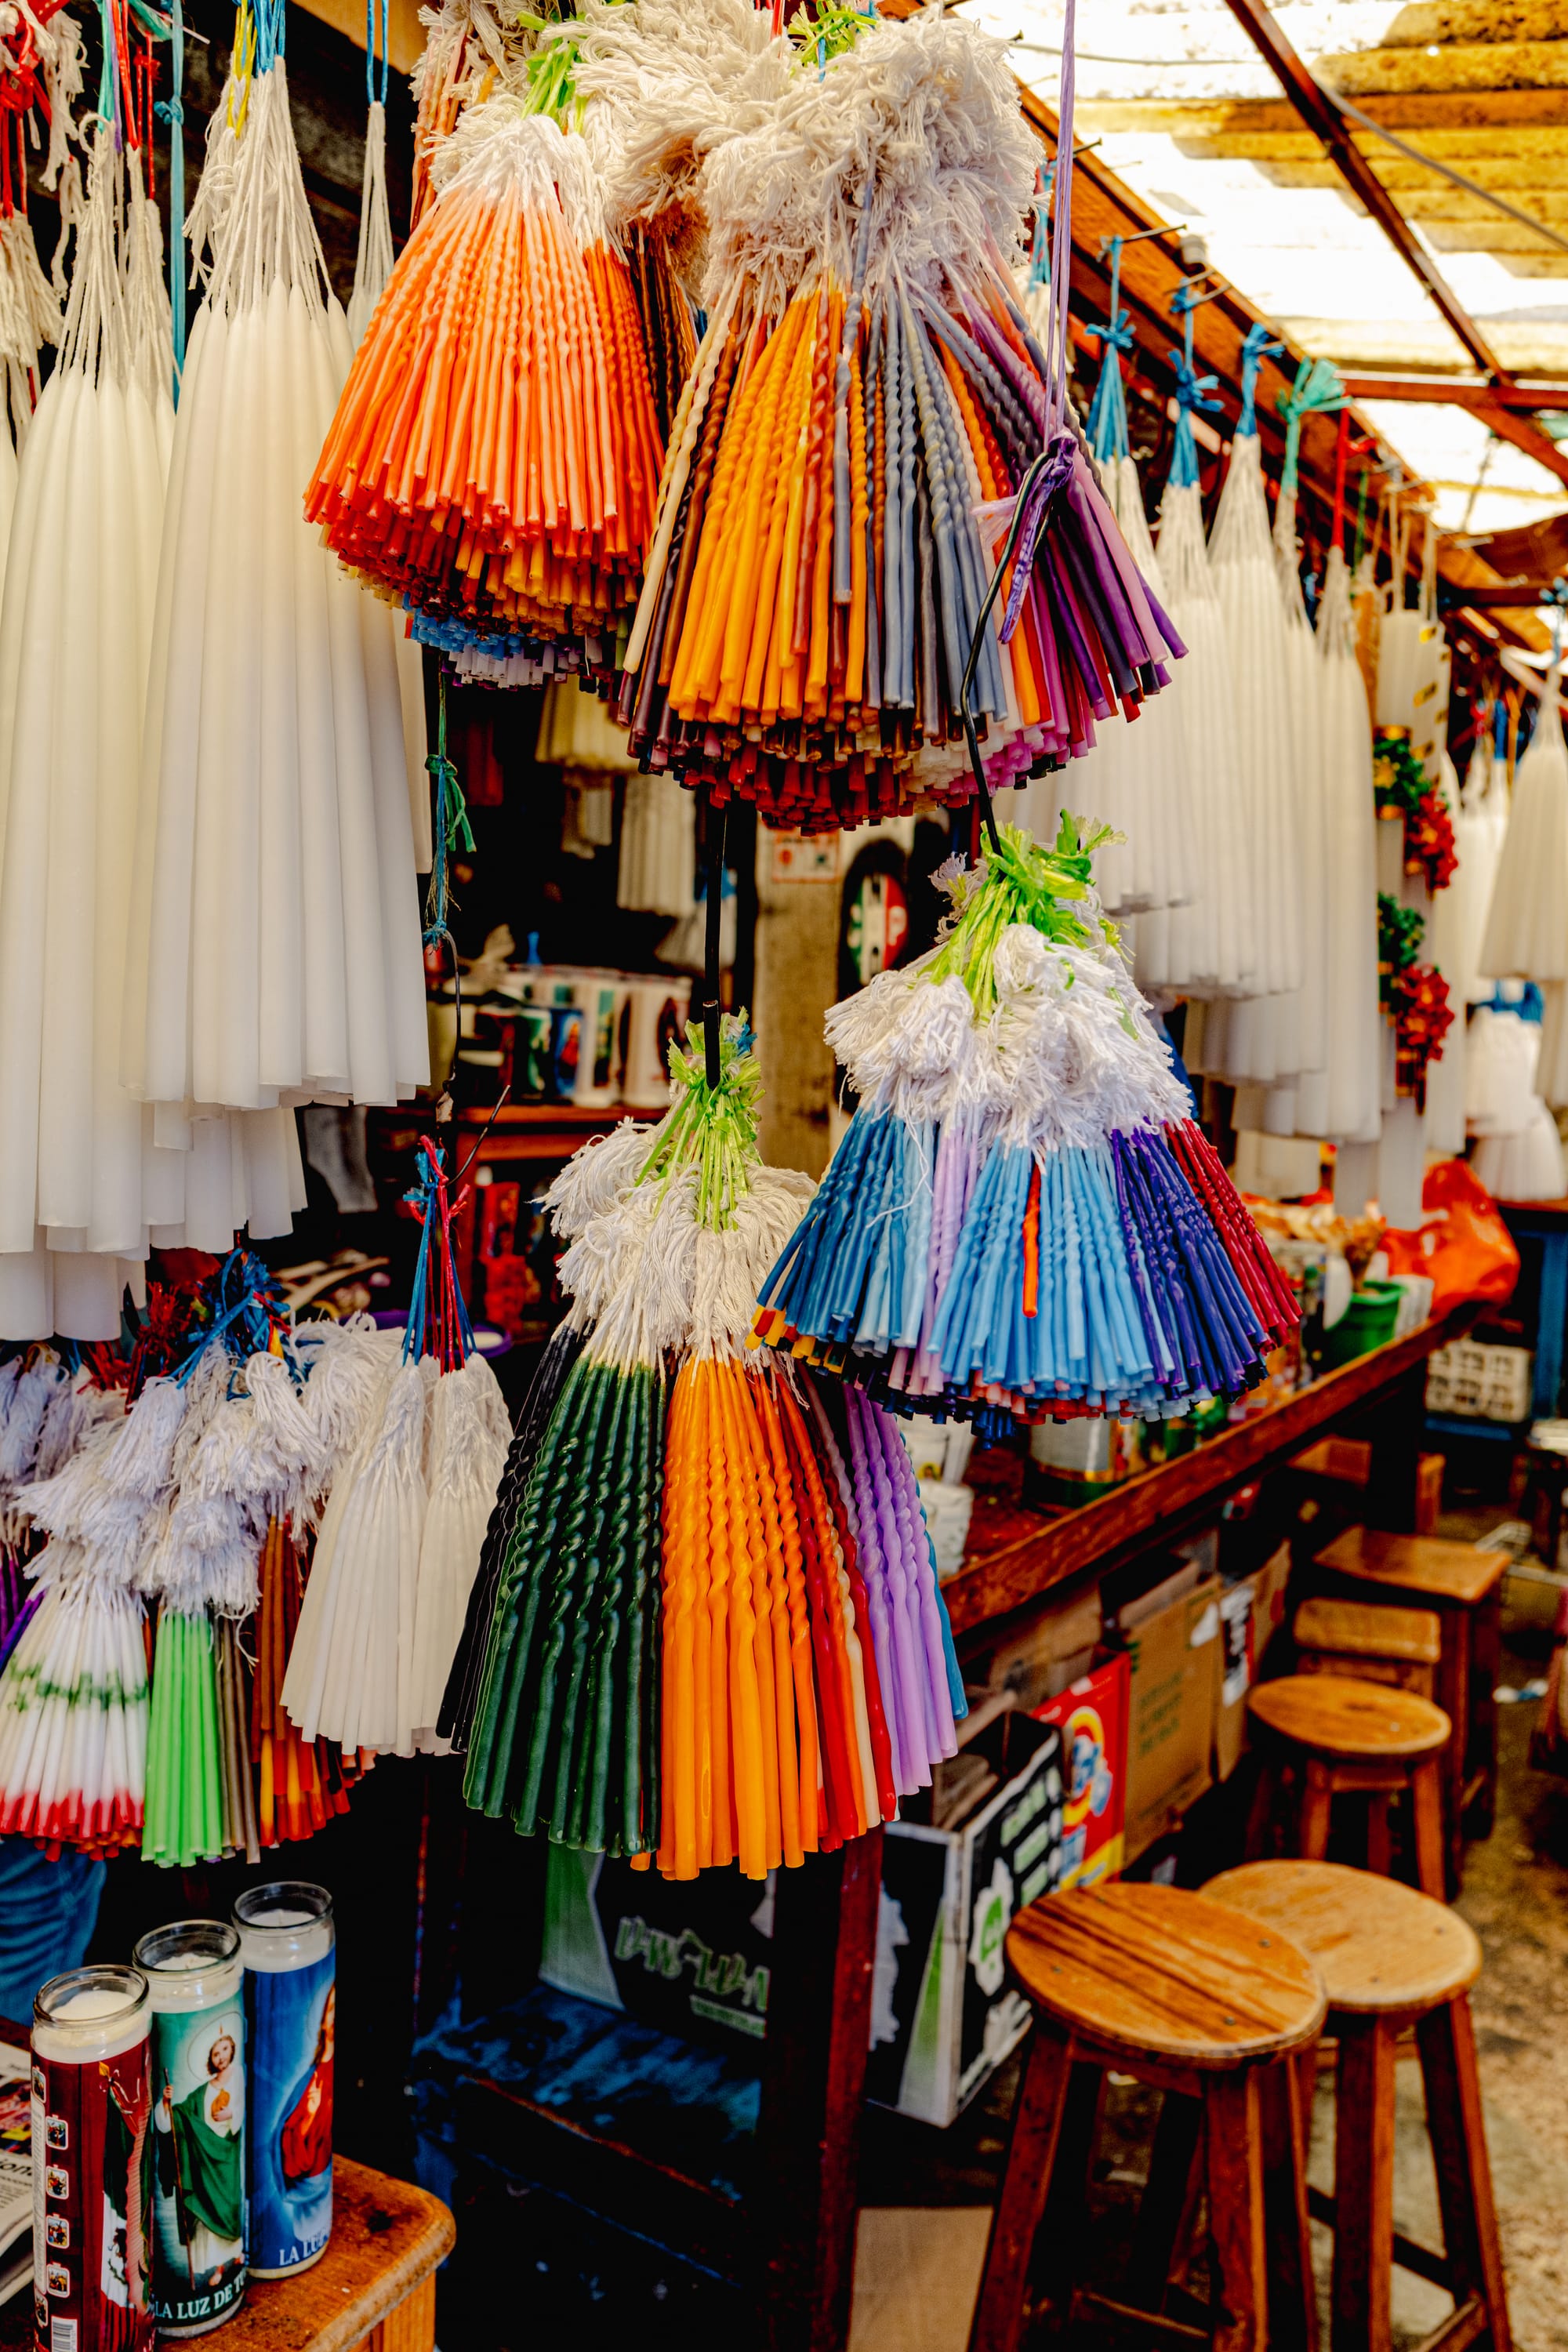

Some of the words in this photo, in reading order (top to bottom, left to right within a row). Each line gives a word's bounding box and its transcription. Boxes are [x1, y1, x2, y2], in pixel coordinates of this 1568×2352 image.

[279, 2245, 299, 2266] LA
[154, 2300, 173, 2319] LA
[176, 2296, 211, 2319] LUZ
[213, 2282, 234, 2310] DE
